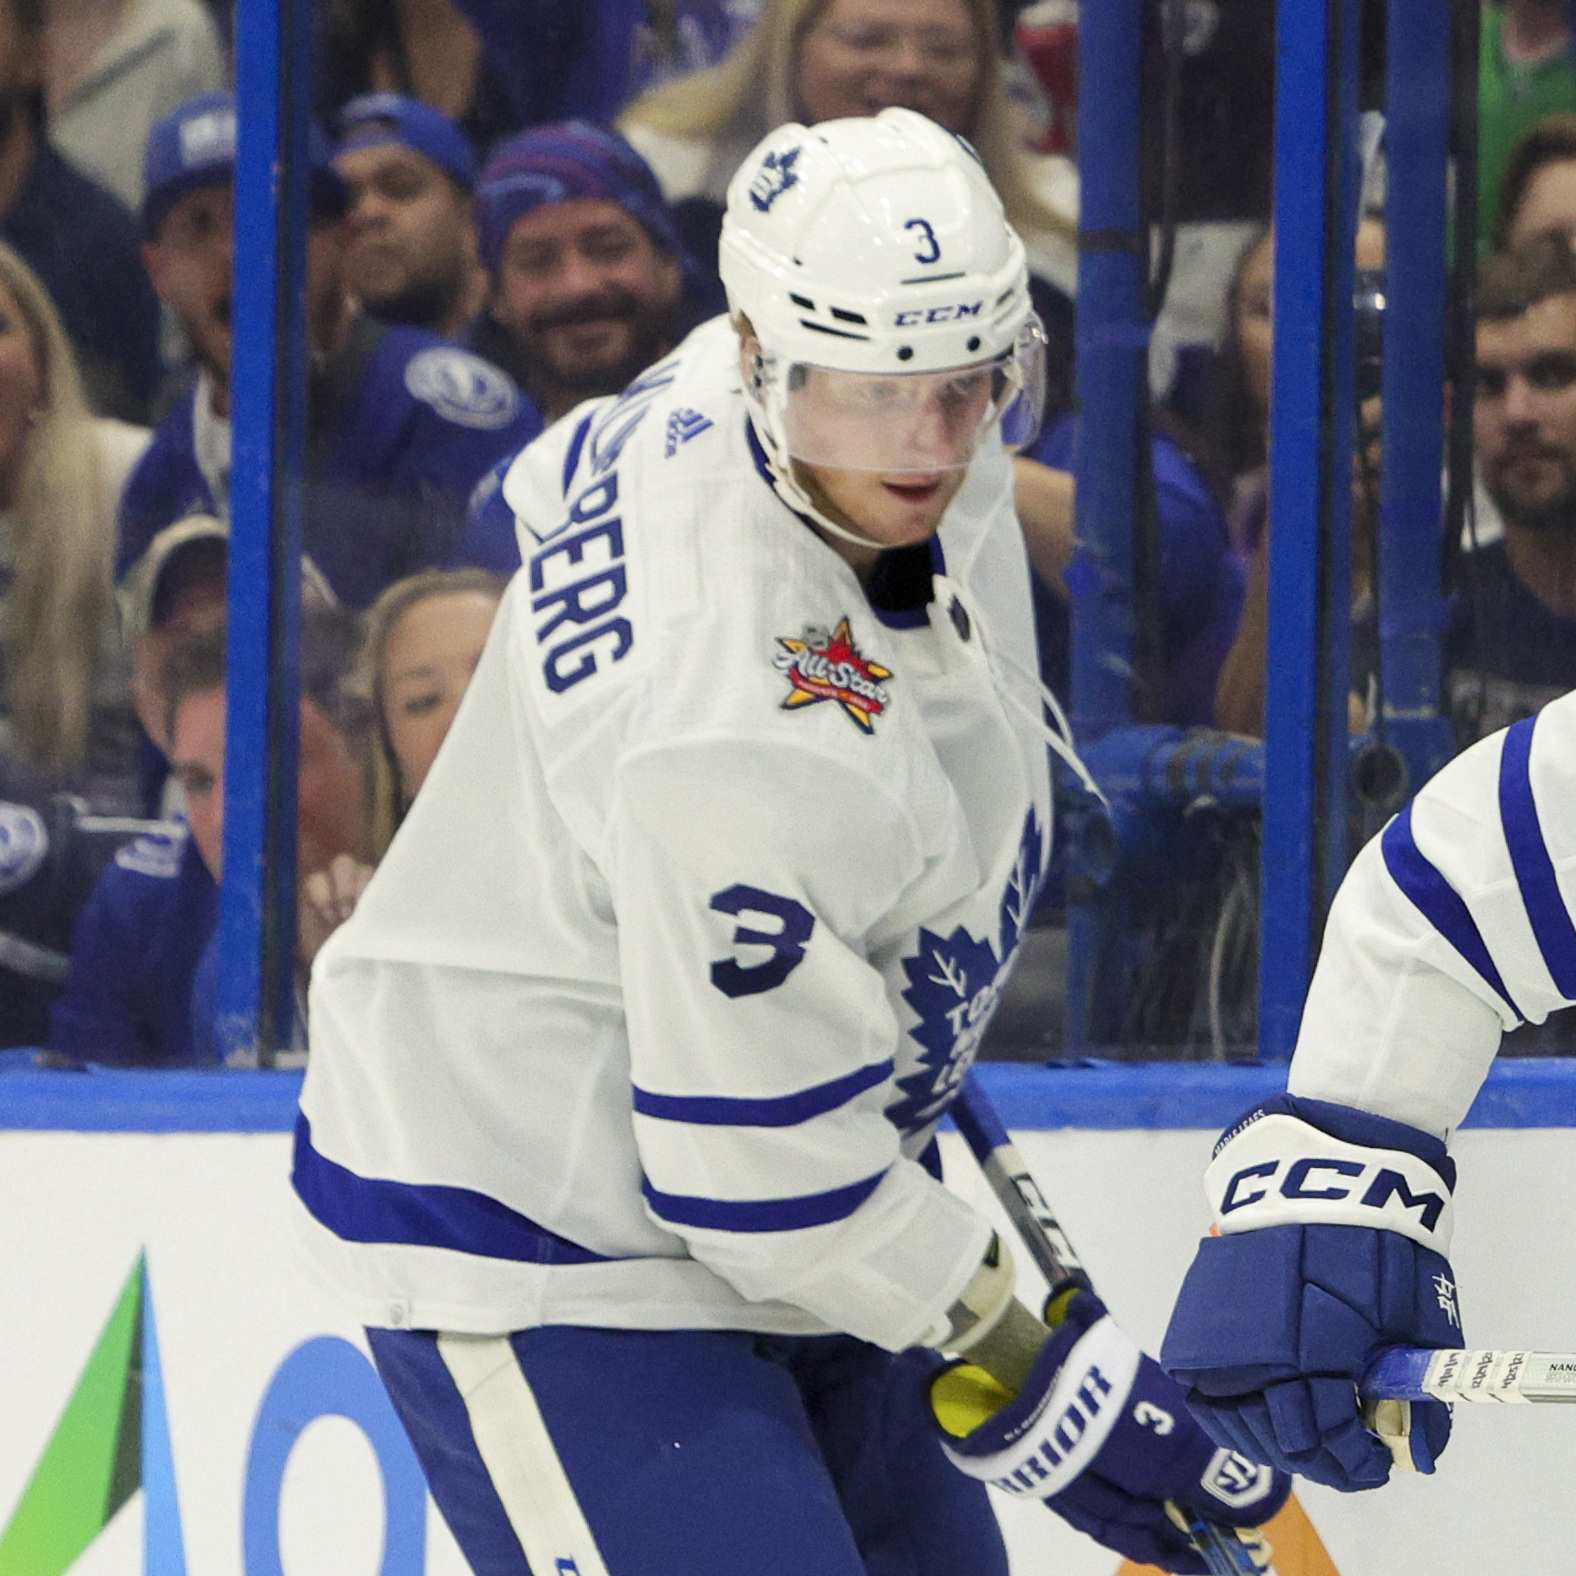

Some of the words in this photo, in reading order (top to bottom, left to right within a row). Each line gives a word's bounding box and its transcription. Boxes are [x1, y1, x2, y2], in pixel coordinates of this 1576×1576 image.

[904, 218, 941, 264] 3
[894, 300, 982, 327] CCM
[709, 883, 816, 999] 3
[1220, 1158, 1445, 1233] CCM
[1133, 1401, 1175, 1435] 3
